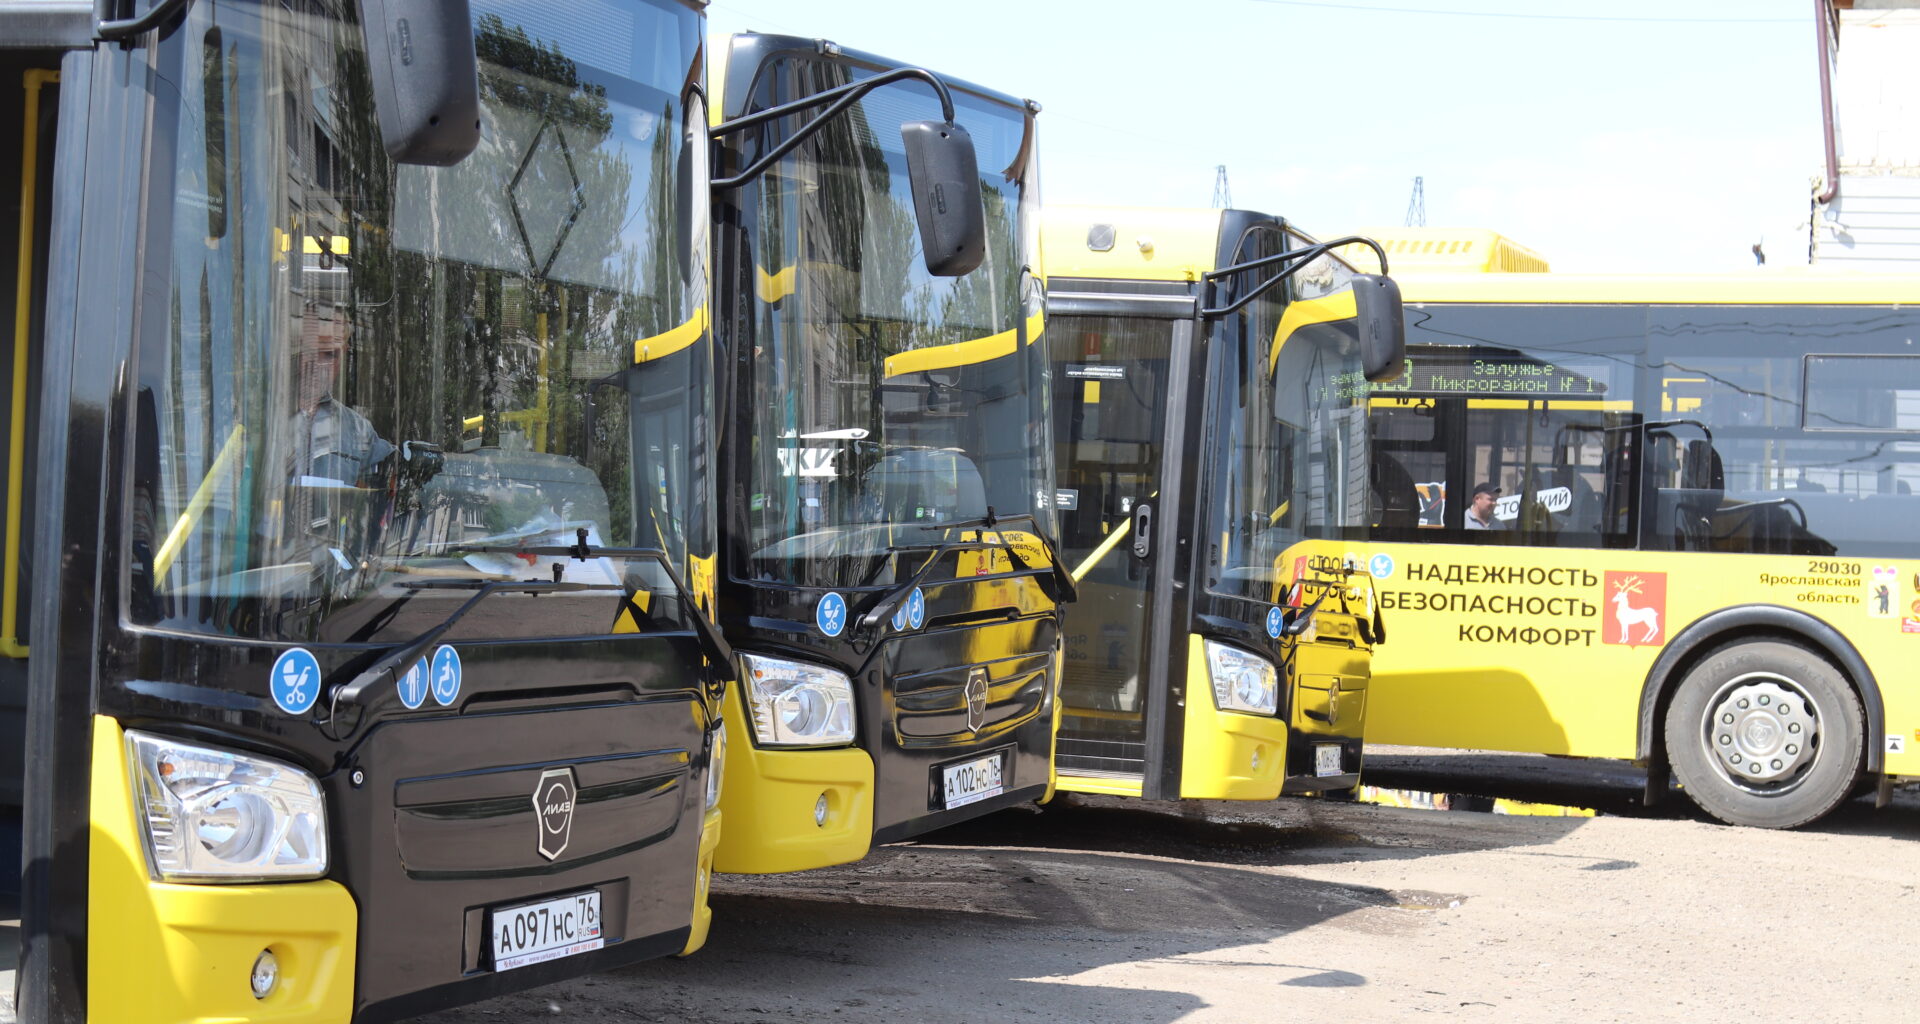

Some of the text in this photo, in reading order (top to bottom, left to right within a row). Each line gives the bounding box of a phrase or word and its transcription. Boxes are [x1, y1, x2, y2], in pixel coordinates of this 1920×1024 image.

[1473, 360, 1554, 376] Залужье
[1431, 375, 1548, 392] Микрорайон
[1587, 377, 1593, 392] 1
[1407, 563, 1598, 587] НАДЕЖНОСТЬ
[1808, 561, 1861, 575] 29030
[1760, 573, 1861, 587] Ярославская
[1381, 591, 1597, 617] БЕЗОПАСНОСТЬ
[1797, 591, 1860, 604] область
[1459, 624, 1596, 647] КОМФОРТ
[578, 897, 595, 925] 76
